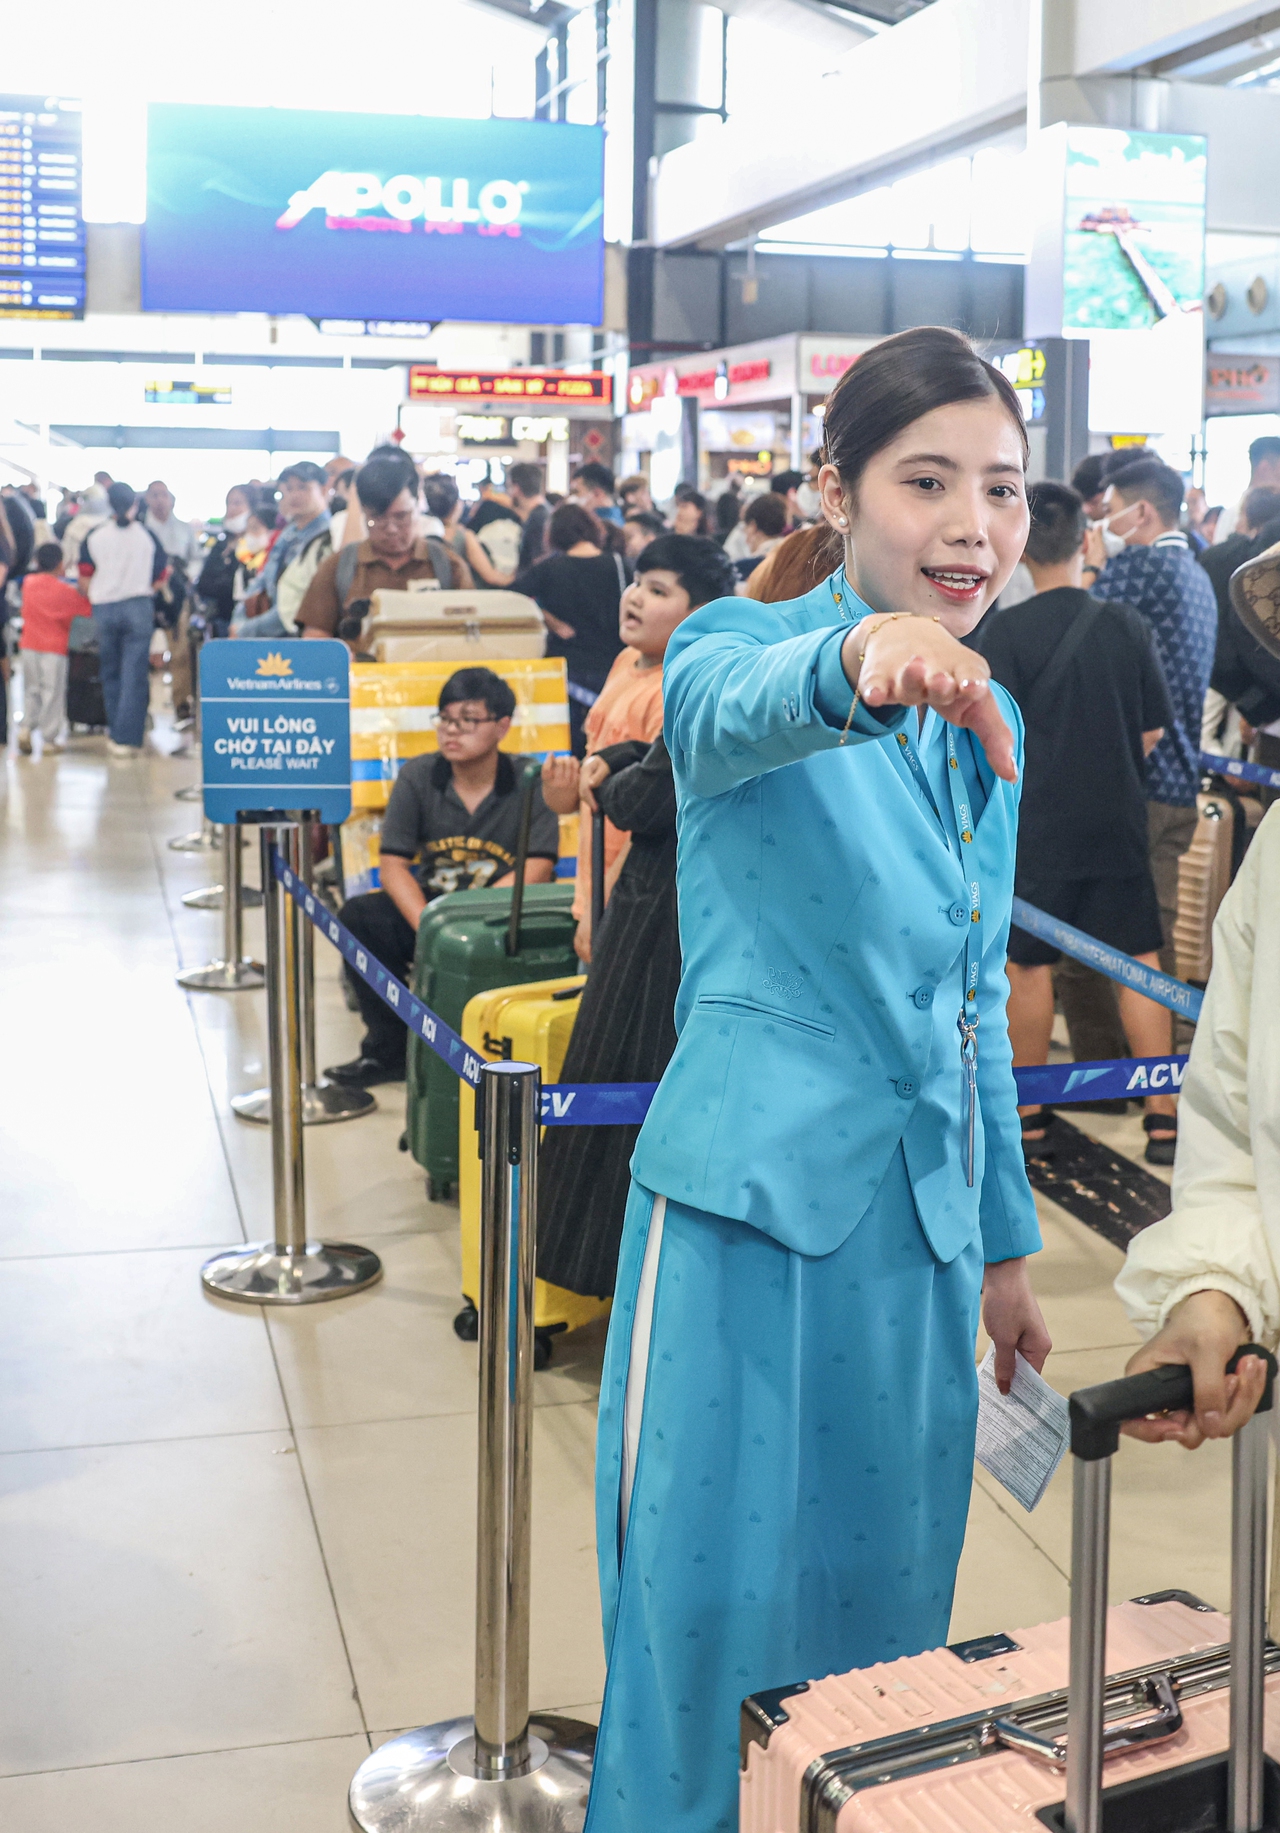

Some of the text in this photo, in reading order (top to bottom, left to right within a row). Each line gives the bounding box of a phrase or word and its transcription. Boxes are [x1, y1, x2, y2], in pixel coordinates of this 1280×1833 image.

[276, 171, 522, 229] APOLLO
[227, 714, 317, 734] VUI LÒNG
[214, 735, 335, 758] CHỜ TẠI ĐÂY
[904, 745, 919, 771] VIAGS
[231, 757, 319, 770] PLEASE WAIT
[958, 803, 970, 830] VIAGS
[970, 881, 981, 909] VIAGS
[969, 961, 980, 988] VIAGS
[1149, 974, 1191, 1008] AIRPORT
